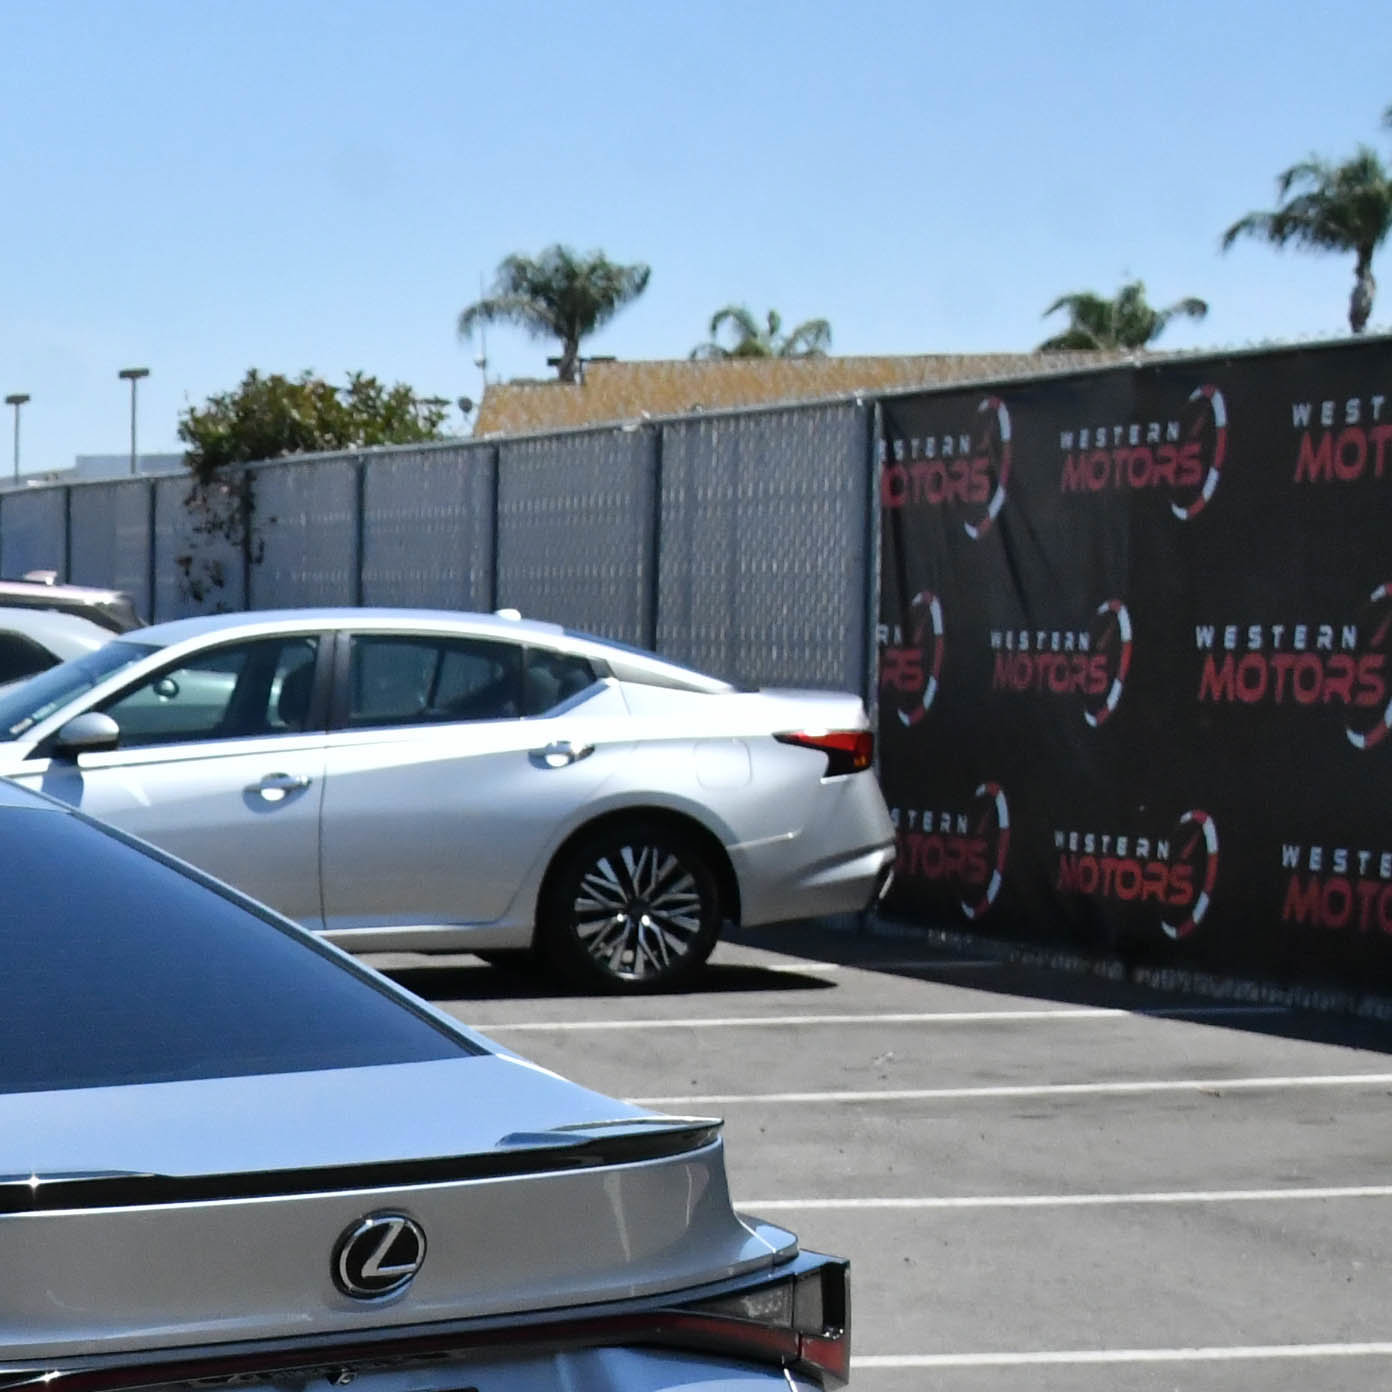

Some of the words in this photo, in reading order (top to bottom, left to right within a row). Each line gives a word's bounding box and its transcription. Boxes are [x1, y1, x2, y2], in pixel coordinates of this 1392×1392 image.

[1292, 395, 1385, 428] WEST
[1060, 420, 1181, 450] WESTERN
[1293, 424, 1392, 483] MOT
[1062, 441, 1203, 493] MOTORS
[990, 630, 1091, 652] WESTERN
[1195, 624, 1358, 650] WESTERN
[992, 652, 1108, 695] MOTORS
[1197, 652, 1386, 706] MOTORS
[1054, 830, 1171, 860] WESTERN
[1056, 854, 1194, 906] MOTORS
